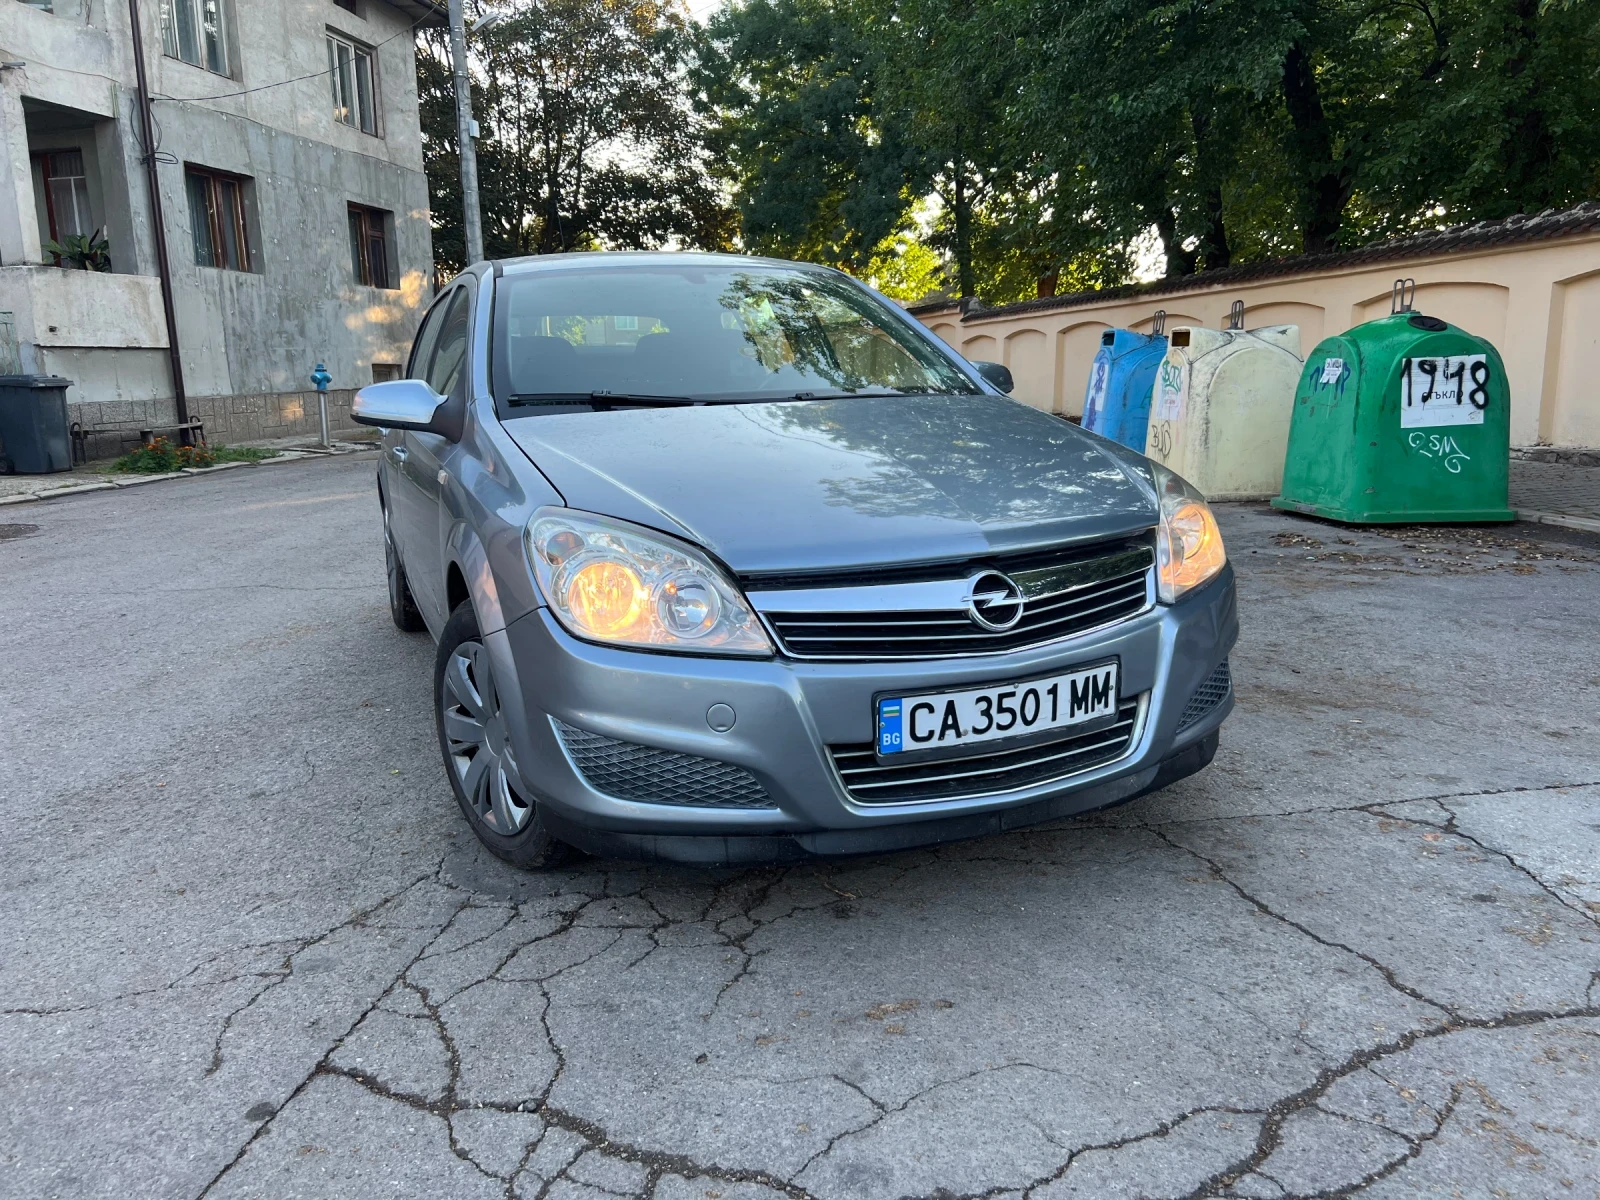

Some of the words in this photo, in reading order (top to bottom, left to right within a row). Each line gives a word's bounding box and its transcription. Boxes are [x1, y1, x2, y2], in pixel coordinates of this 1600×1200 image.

[1422, 389, 1464, 401] стъкл
[909, 700, 962, 743] CA
[971, 683, 1059, 735] 3501
[1069, 671, 1112, 719] MM
[883, 732, 900, 746] BG
